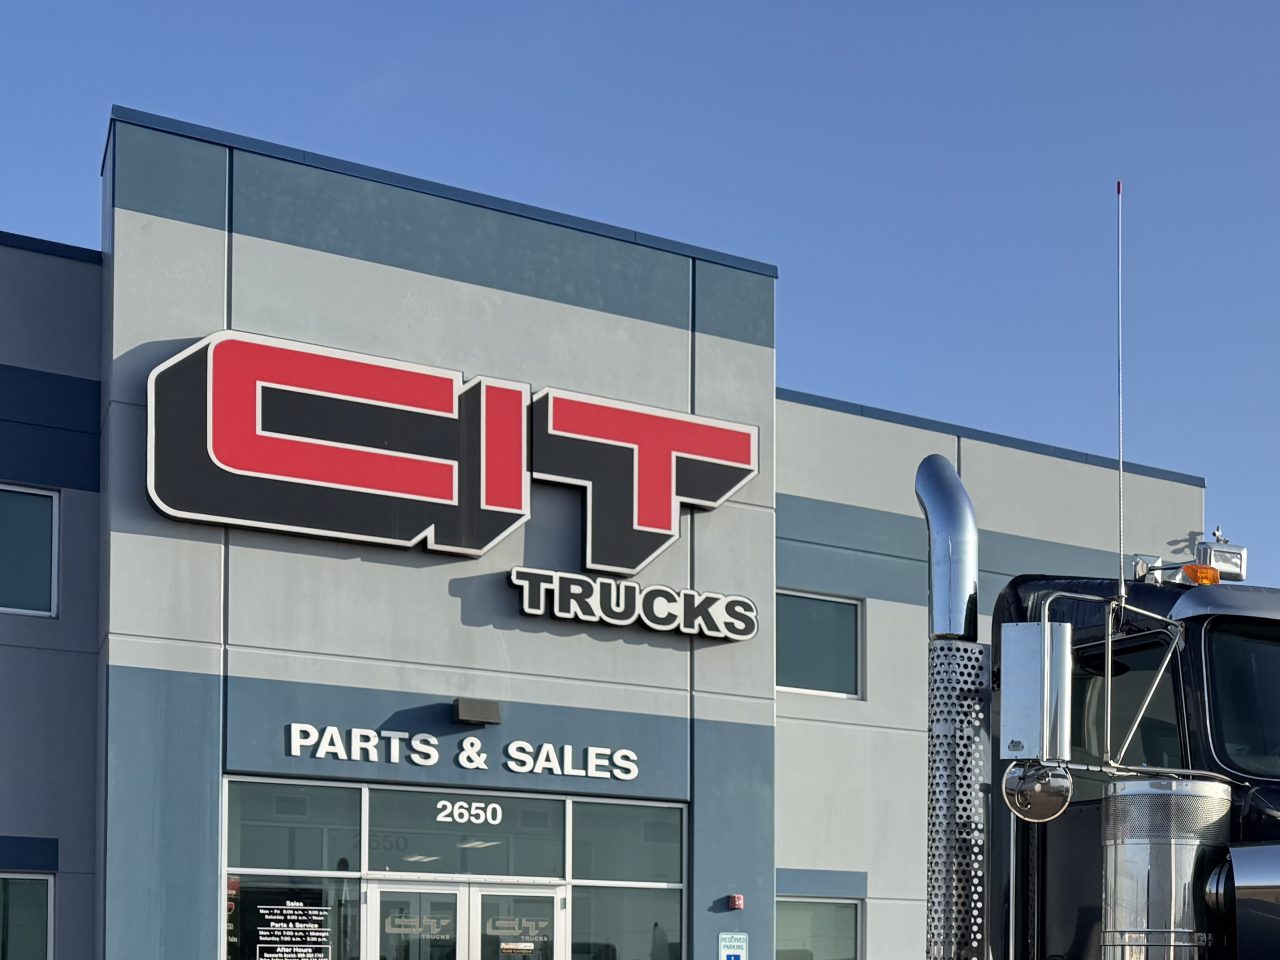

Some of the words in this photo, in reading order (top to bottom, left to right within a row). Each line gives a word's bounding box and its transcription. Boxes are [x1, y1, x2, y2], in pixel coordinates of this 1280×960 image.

[147, 330, 759, 576] CIT
[511, 566, 758, 640] TRUCKS
[288, 722, 439, 767] PARTS
[458, 736, 488, 771] &
[507, 740, 639, 781] SALES
[436, 800, 503, 825] 2650
